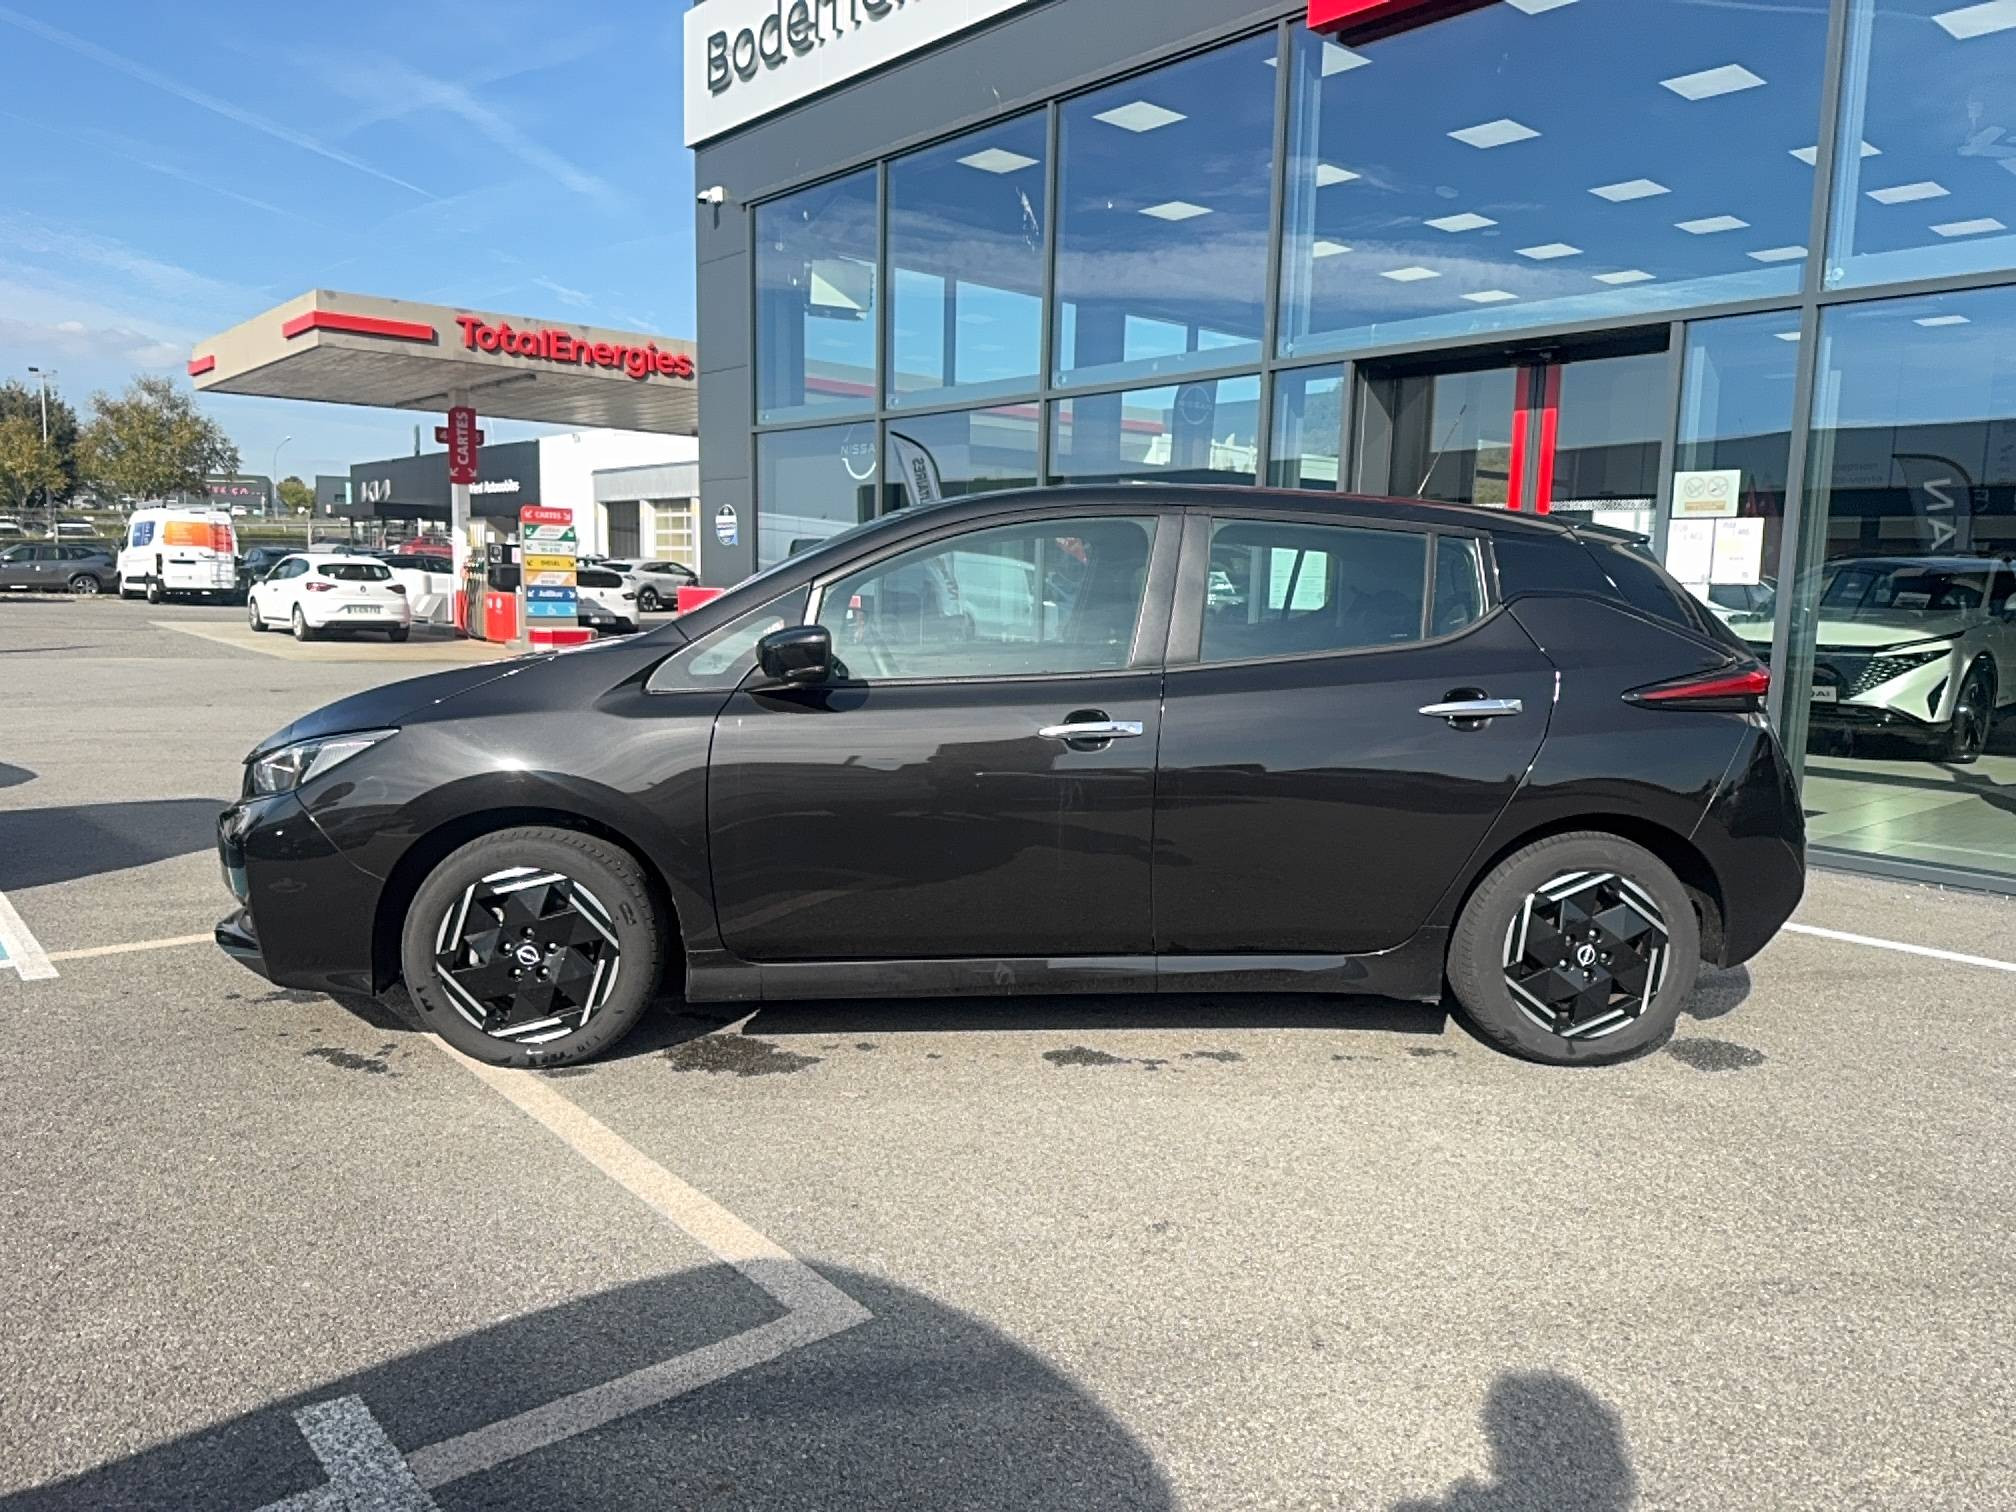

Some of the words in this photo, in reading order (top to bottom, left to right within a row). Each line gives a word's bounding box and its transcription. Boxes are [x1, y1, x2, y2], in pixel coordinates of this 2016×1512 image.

[455, 314, 694, 380] TotalEnergies
[456, 411, 470, 466] CARTES
[840, 443, 877, 456] NISSA
[360, 479, 391, 503] KIA
